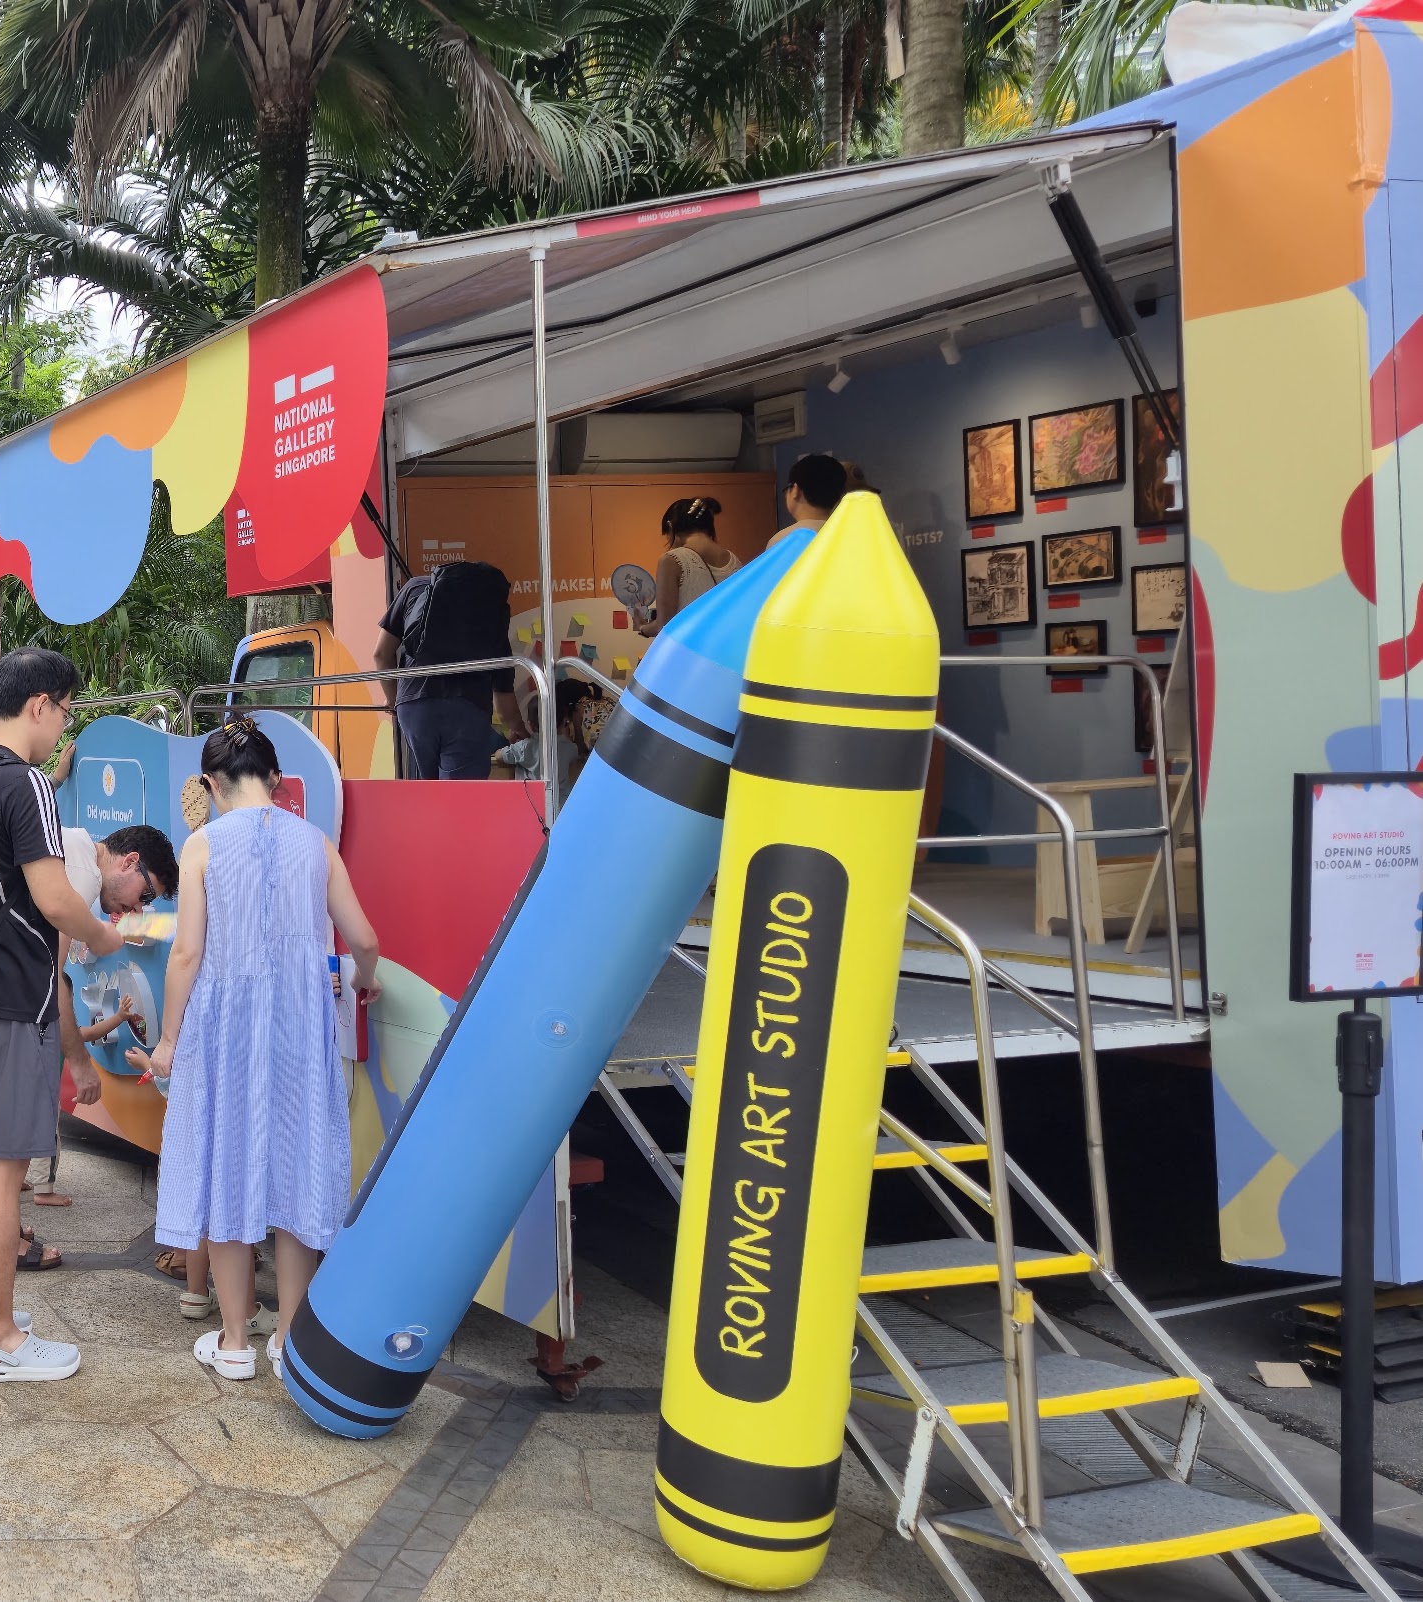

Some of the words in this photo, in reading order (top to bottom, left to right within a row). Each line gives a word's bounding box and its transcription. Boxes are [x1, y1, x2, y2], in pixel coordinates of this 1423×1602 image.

[638, 213, 657, 223] MIND
[659, 209, 679, 219] YOUR
[681, 206, 702, 215] HEAD
[274, 394, 335, 433] NATIONAL
[275, 419, 335, 457] GALLERY
[275, 445, 336, 479] SINGAPORE
[905, 531, 943, 547] TISTS?
[422, 553, 466, 562] NATIONAL
[513, 580, 540, 593] ART
[87, 805, 97, 819] Did
[99, 809, 110, 823] you
[112, 807, 133, 823] know?
[1332, 832, 1362, 840] ROVING
[1324, 847, 1373, 857] OPENING
[1377, 846, 1411, 856] HOURS
[1315, 860, 1362, 870] 10:00AM
[1375, 858, 1419, 868] 06:00PM
[751, 891, 813, 1059] STUDIO
[740, 1072, 791, 1168] ART
[720, 1179, 786, 1359] ROVING
